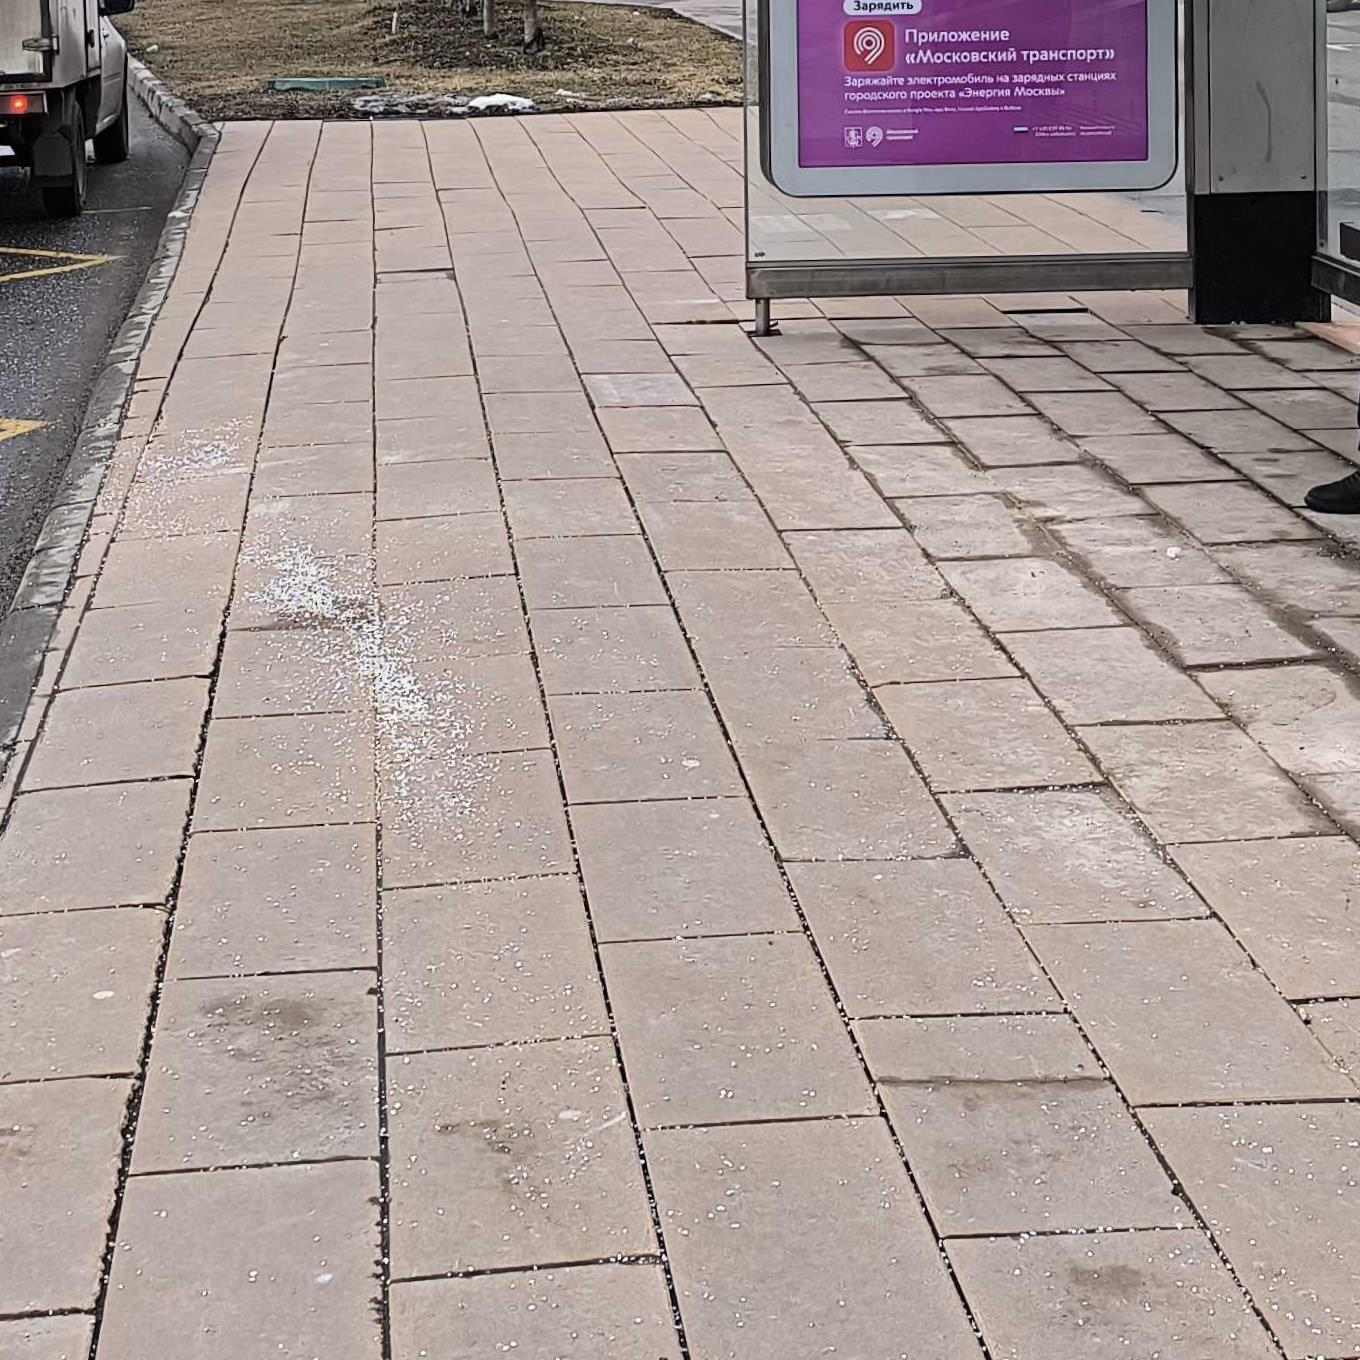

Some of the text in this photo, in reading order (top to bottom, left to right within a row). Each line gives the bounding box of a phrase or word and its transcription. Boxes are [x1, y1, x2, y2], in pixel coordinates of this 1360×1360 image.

[853, 0, 914, 12] Зарядить
[905, 28, 1010, 45] Приложение
[905, 47, 1115, 65] «Московский транспорт»
[844, 71, 1117, 87] Заряжайте электромобиль на зарядных станциях
[844, 86, 1065, 102] городского проекта «Энергия Москвы»
